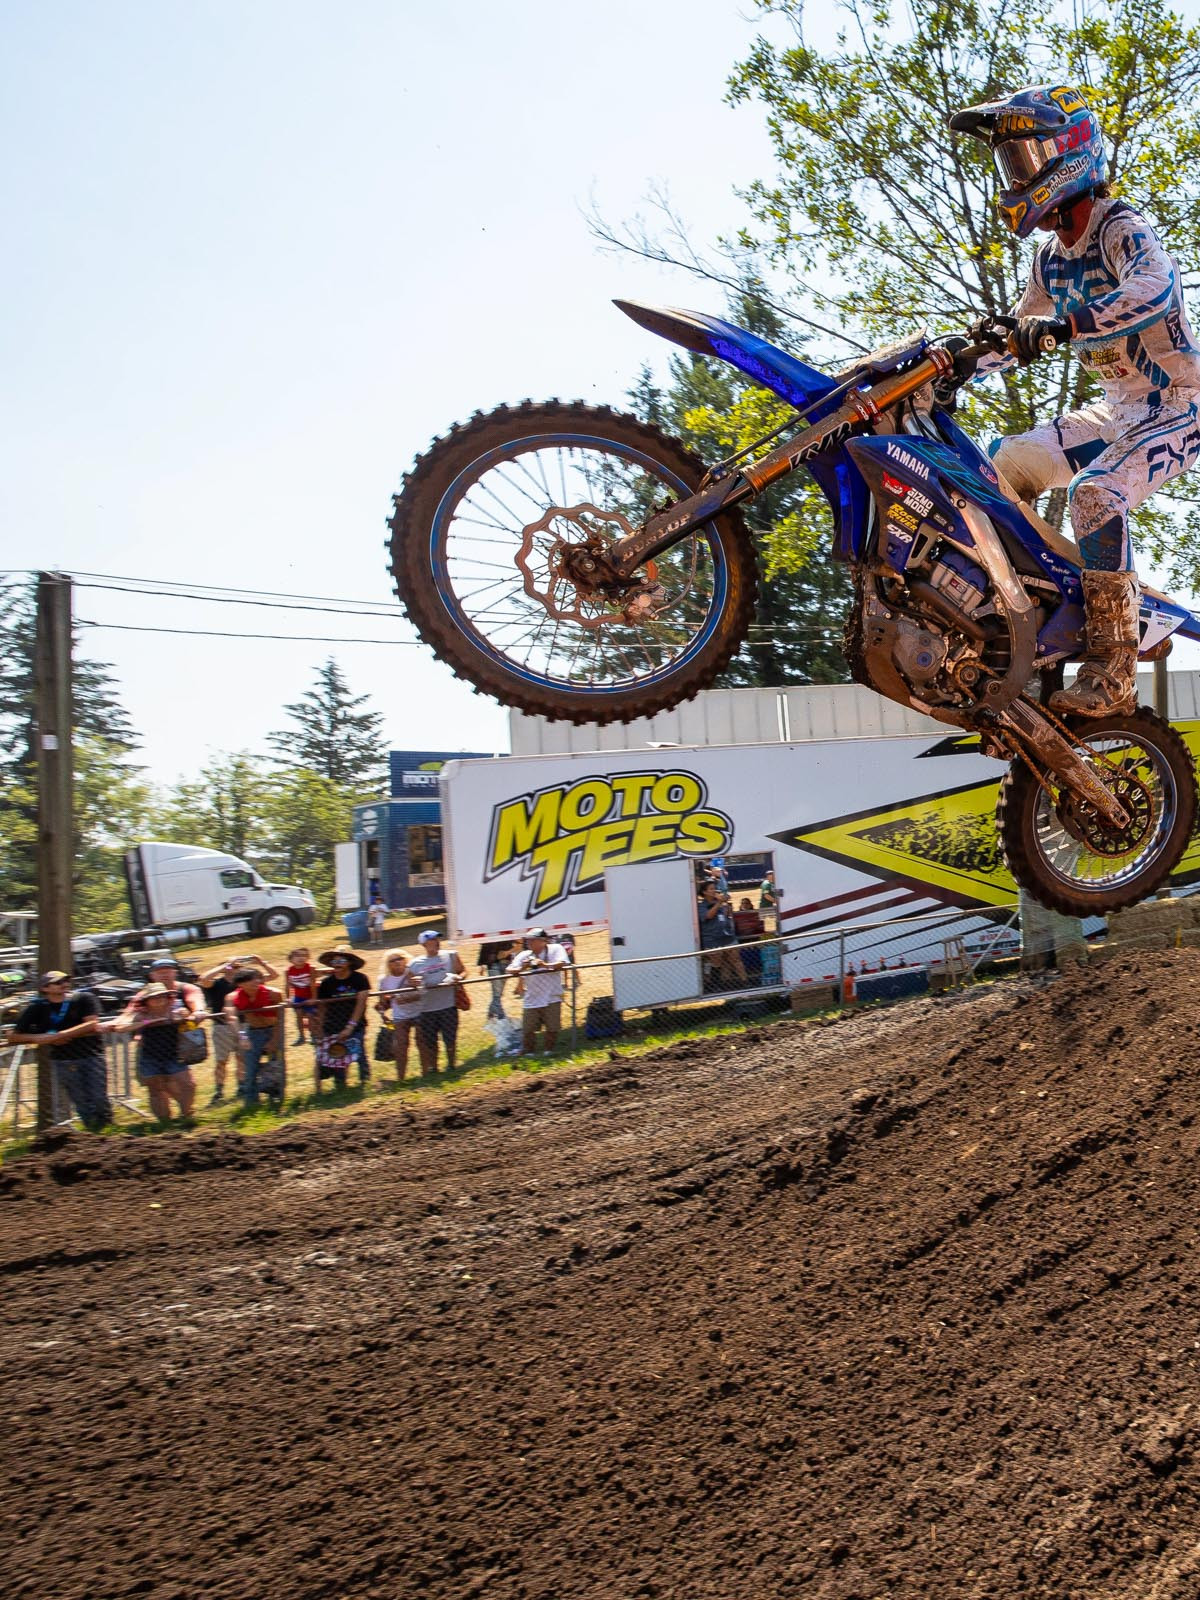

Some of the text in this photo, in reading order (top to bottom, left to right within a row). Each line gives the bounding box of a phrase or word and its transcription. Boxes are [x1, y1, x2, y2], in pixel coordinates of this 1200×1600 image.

[886, 441, 930, 481] YAMAHA
[903, 495, 930, 518] MODS
[907, 486, 934, 510] GIZMO
[886, 509, 918, 532] RIVER
[491, 774, 702, 868] MOTO
[529, 812, 729, 905] TEES
